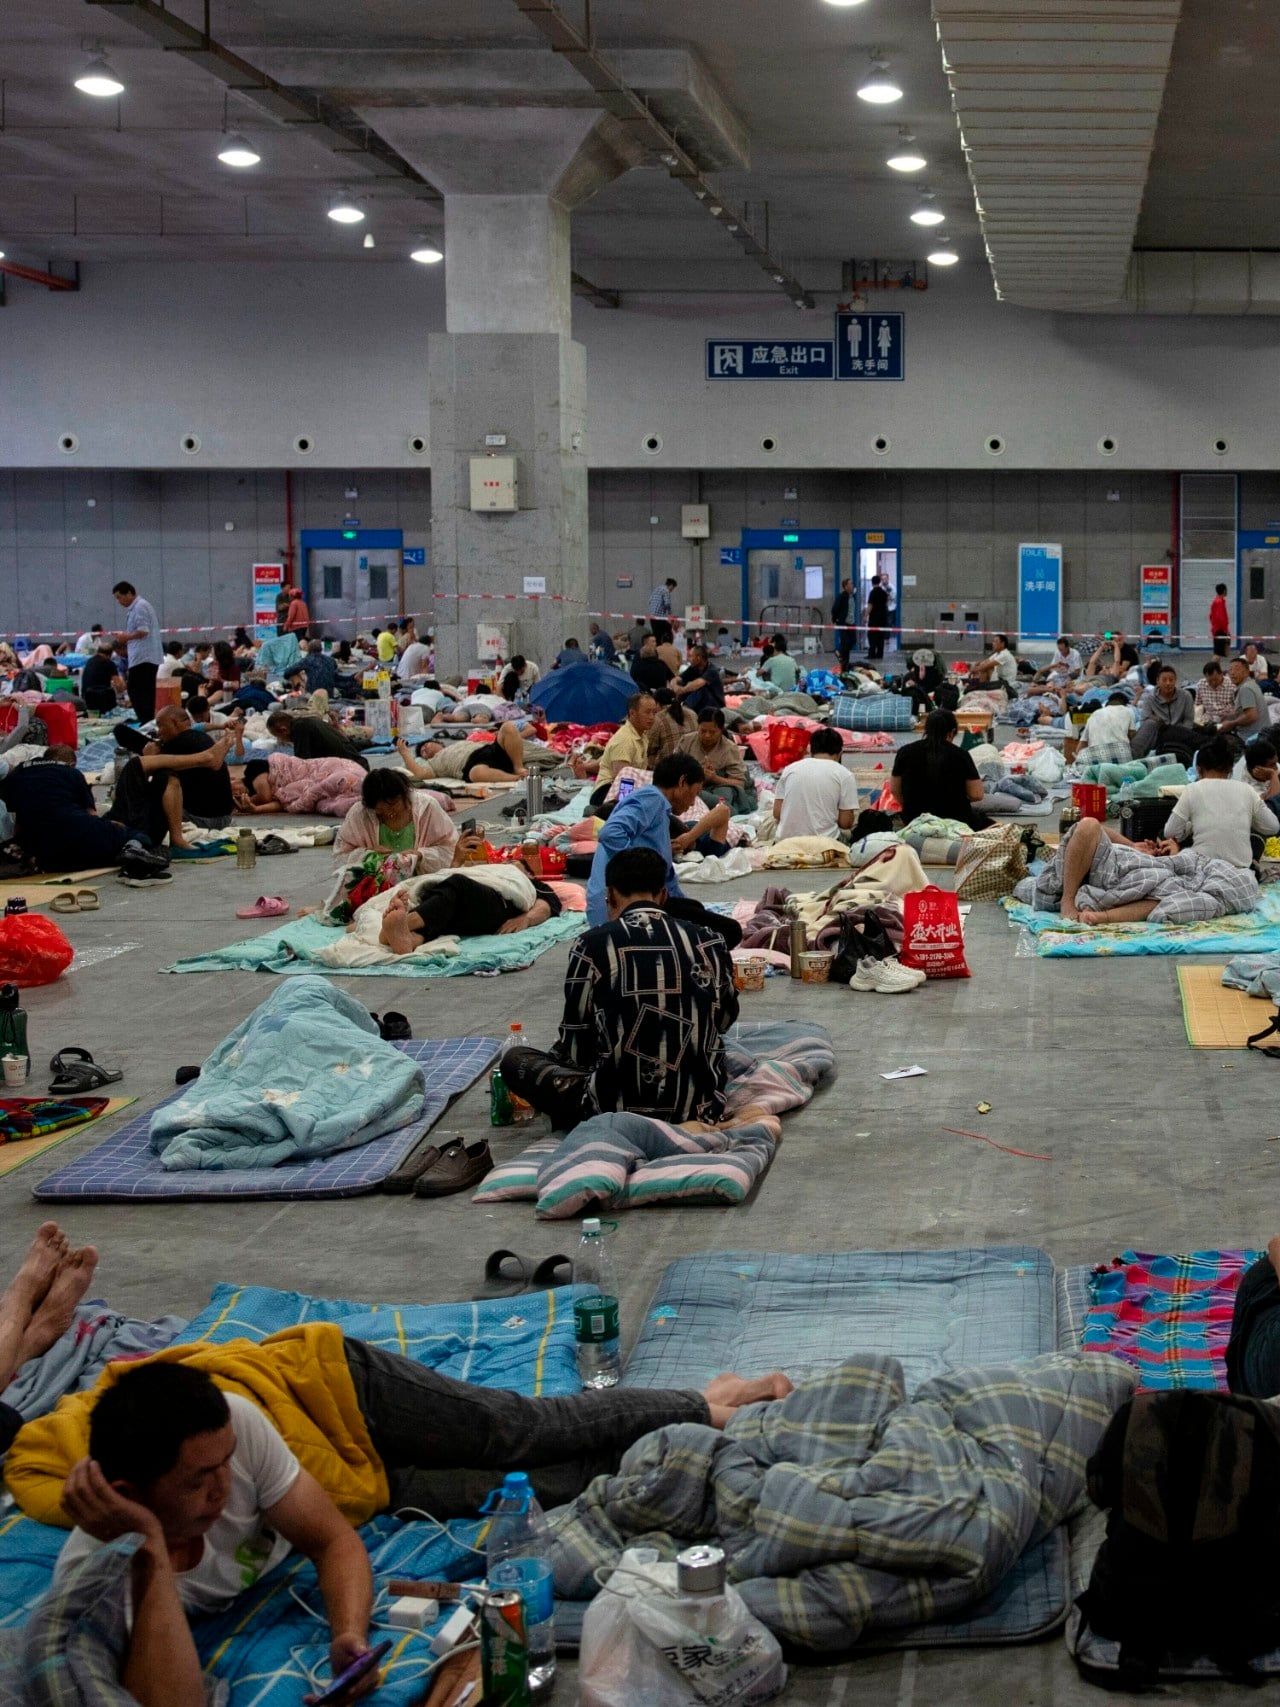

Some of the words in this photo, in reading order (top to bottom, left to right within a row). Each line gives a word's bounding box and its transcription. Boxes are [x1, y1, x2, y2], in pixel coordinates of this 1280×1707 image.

[751, 345, 826, 364] 应急出口
[779, 365, 799, 375] Exit
[851, 358, 889, 371] 洗手间
[1024, 581, 1056, 592] 洗手间
